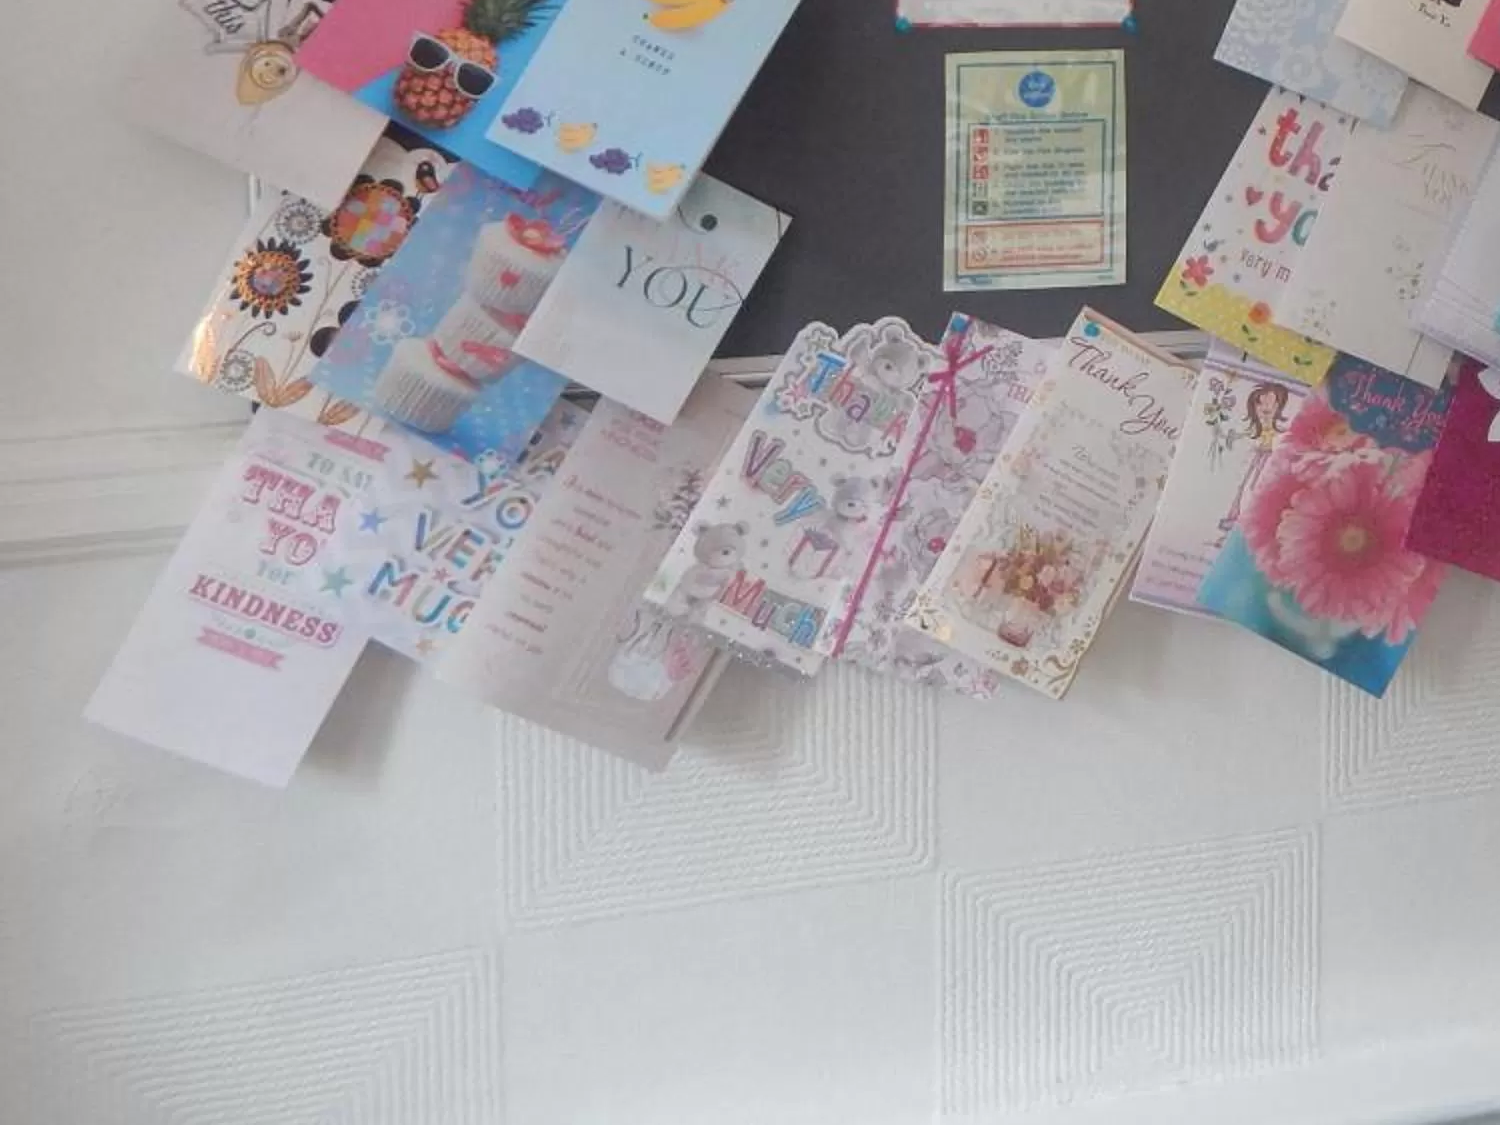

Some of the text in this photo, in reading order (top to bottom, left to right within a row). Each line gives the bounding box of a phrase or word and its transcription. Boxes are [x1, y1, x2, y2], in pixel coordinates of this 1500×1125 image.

[1068, 336, 1150, 406] Thank
[1119, 394, 1179, 440] You
[1345, 369, 1405, 412] Thank
[189, 574, 339, 644] KINDNESS
